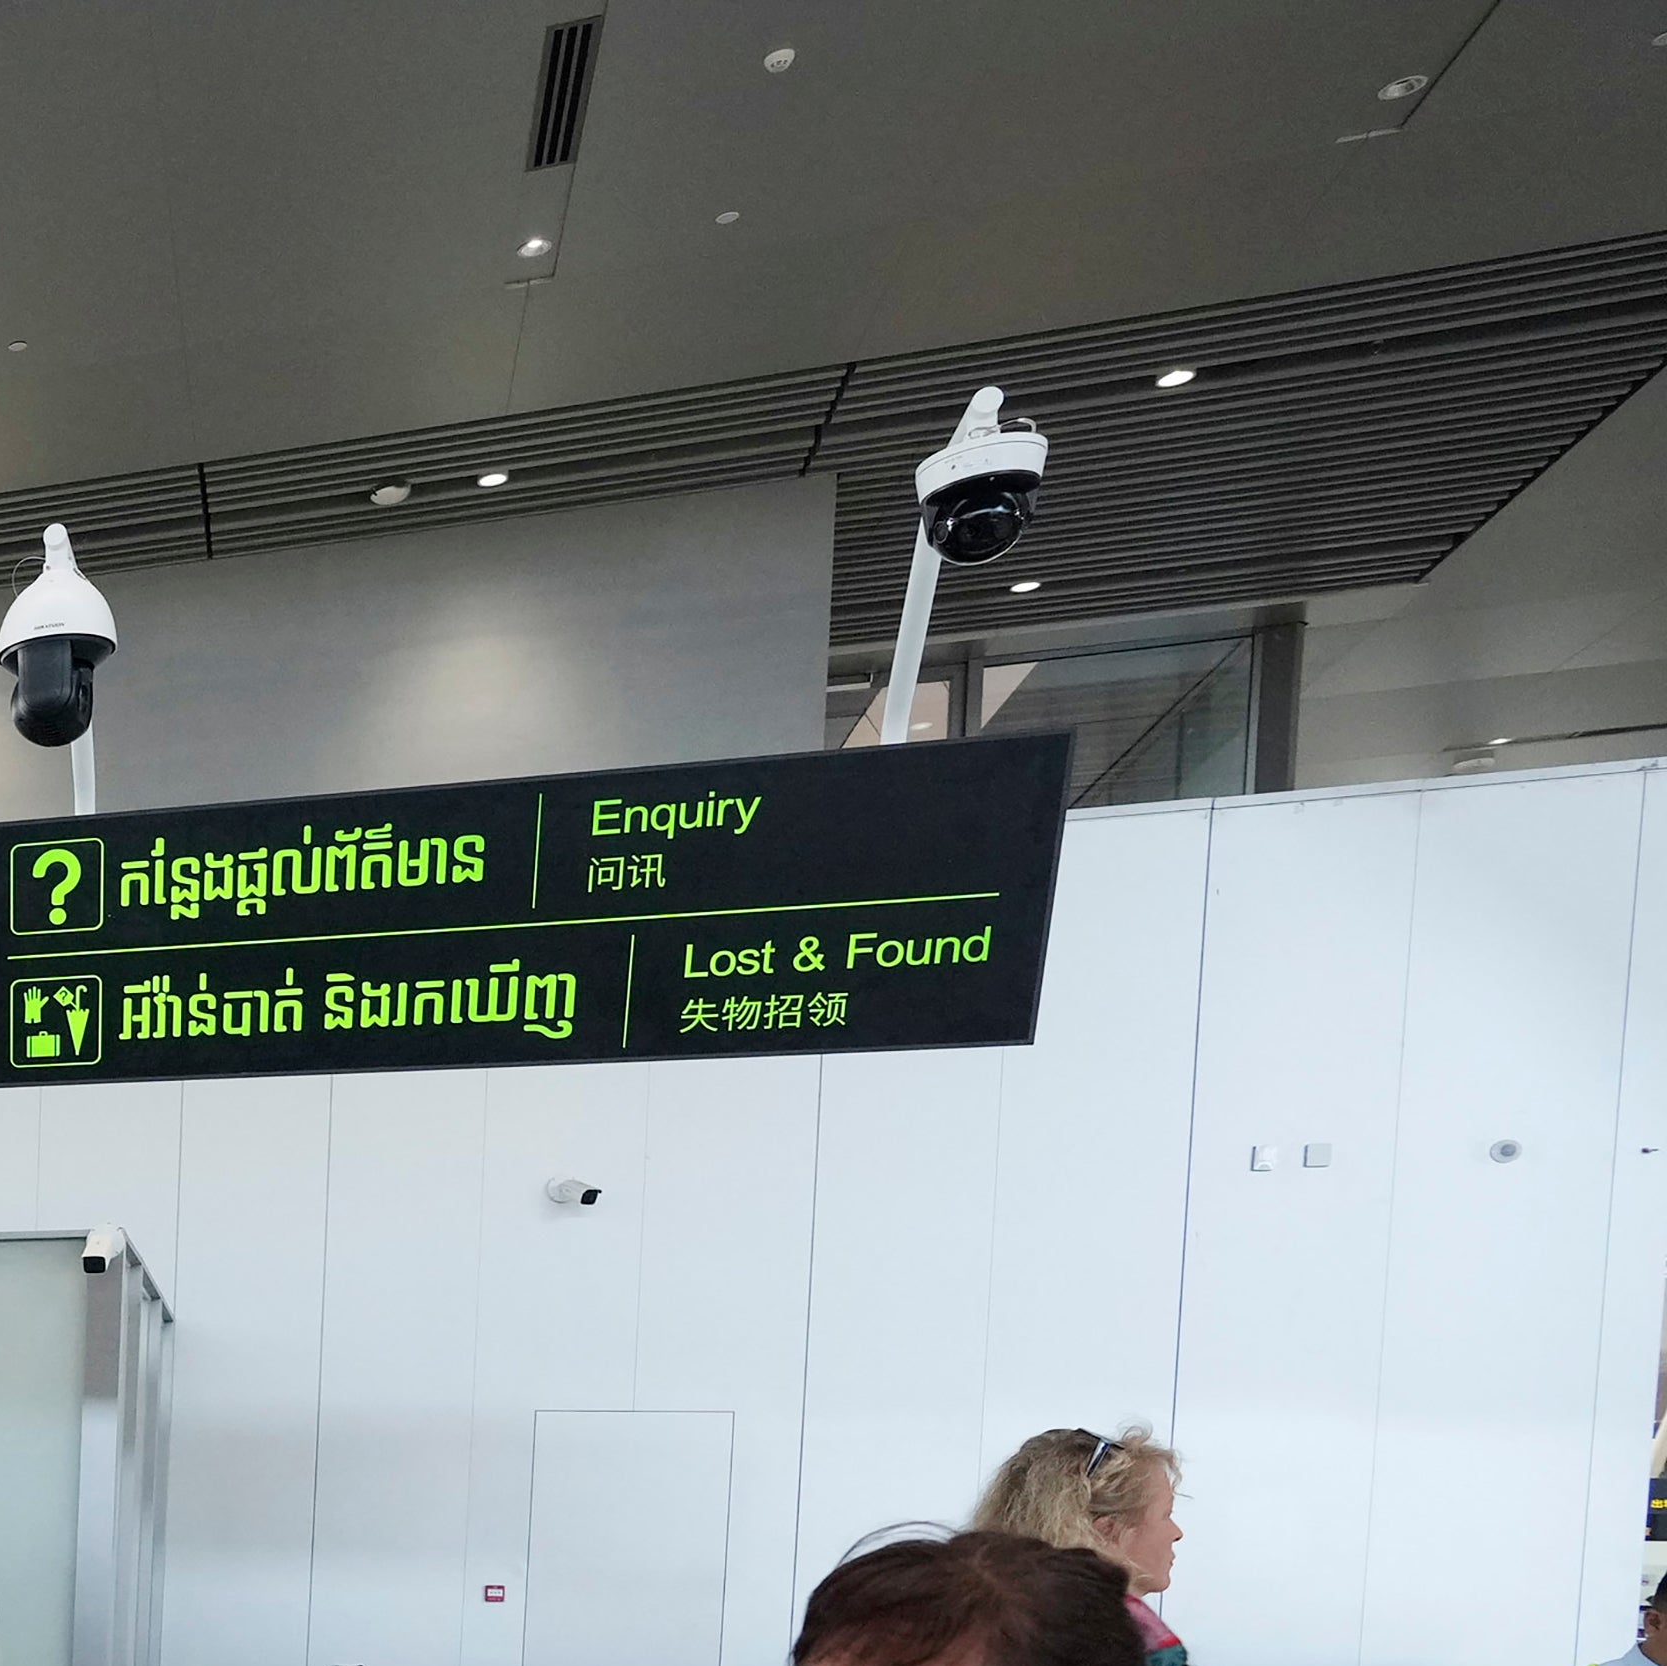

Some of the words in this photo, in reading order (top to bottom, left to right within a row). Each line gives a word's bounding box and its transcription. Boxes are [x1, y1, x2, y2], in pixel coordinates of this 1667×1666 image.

[591, 791, 762, 839] Enquiry
[587, 853, 666, 893] 问讯
[683, 940, 776, 979] Lost
[793, 935, 826, 972] &
[846, 925, 992, 969] Found
[679, 991, 849, 1034] 失物招领
